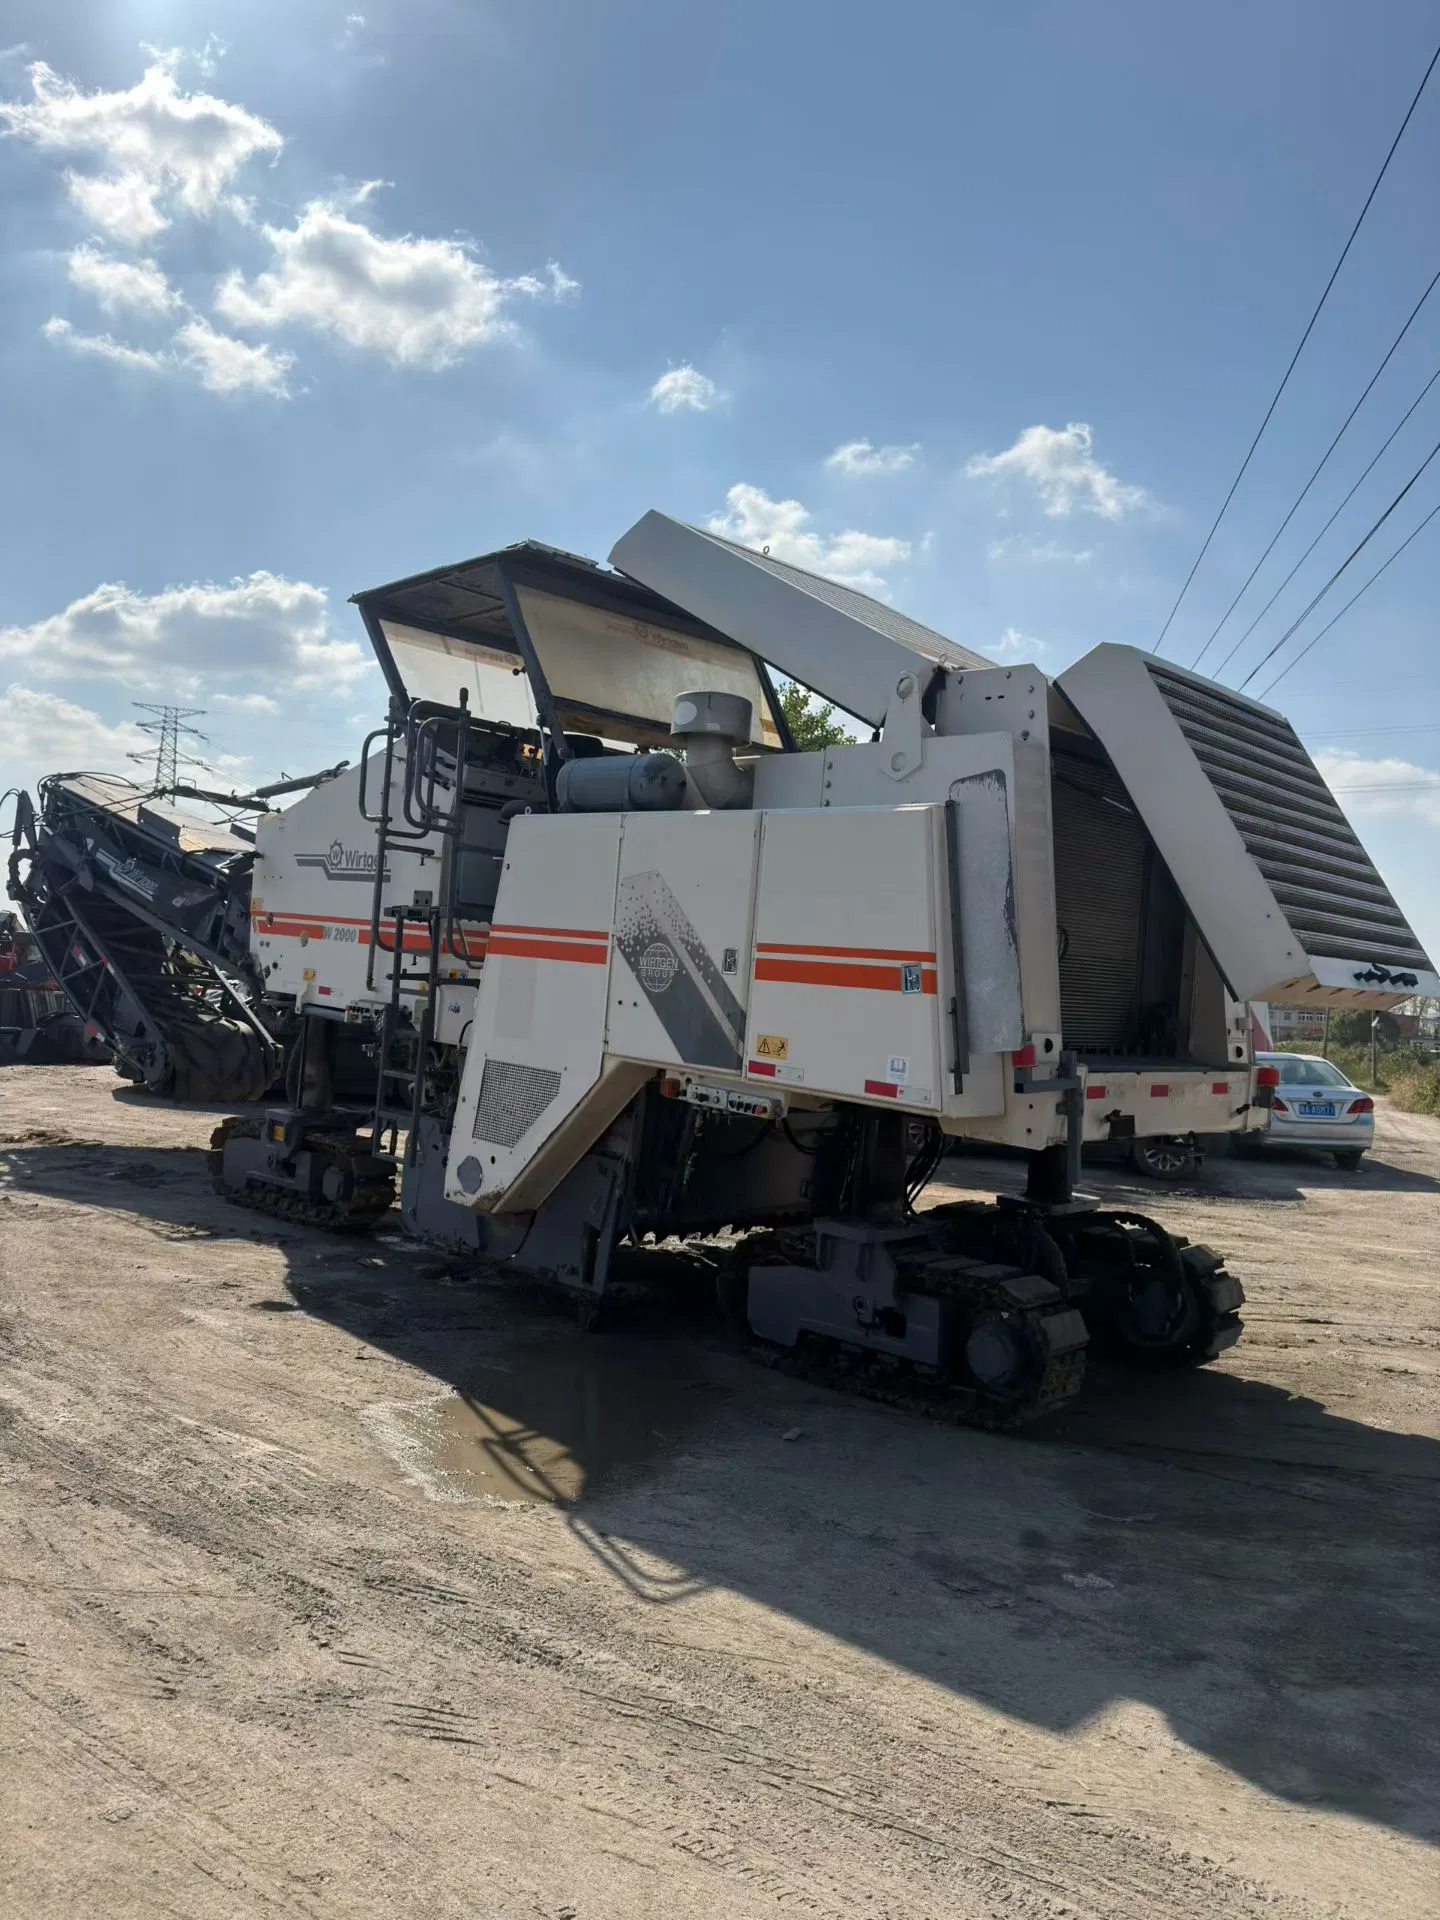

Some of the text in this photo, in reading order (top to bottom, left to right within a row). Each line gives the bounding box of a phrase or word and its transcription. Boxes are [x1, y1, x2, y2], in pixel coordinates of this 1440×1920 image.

[324, 925, 357, 943] W 2000
[639, 956, 679, 969] WIRTGEN
[641, 969, 675, 979] GROUP
